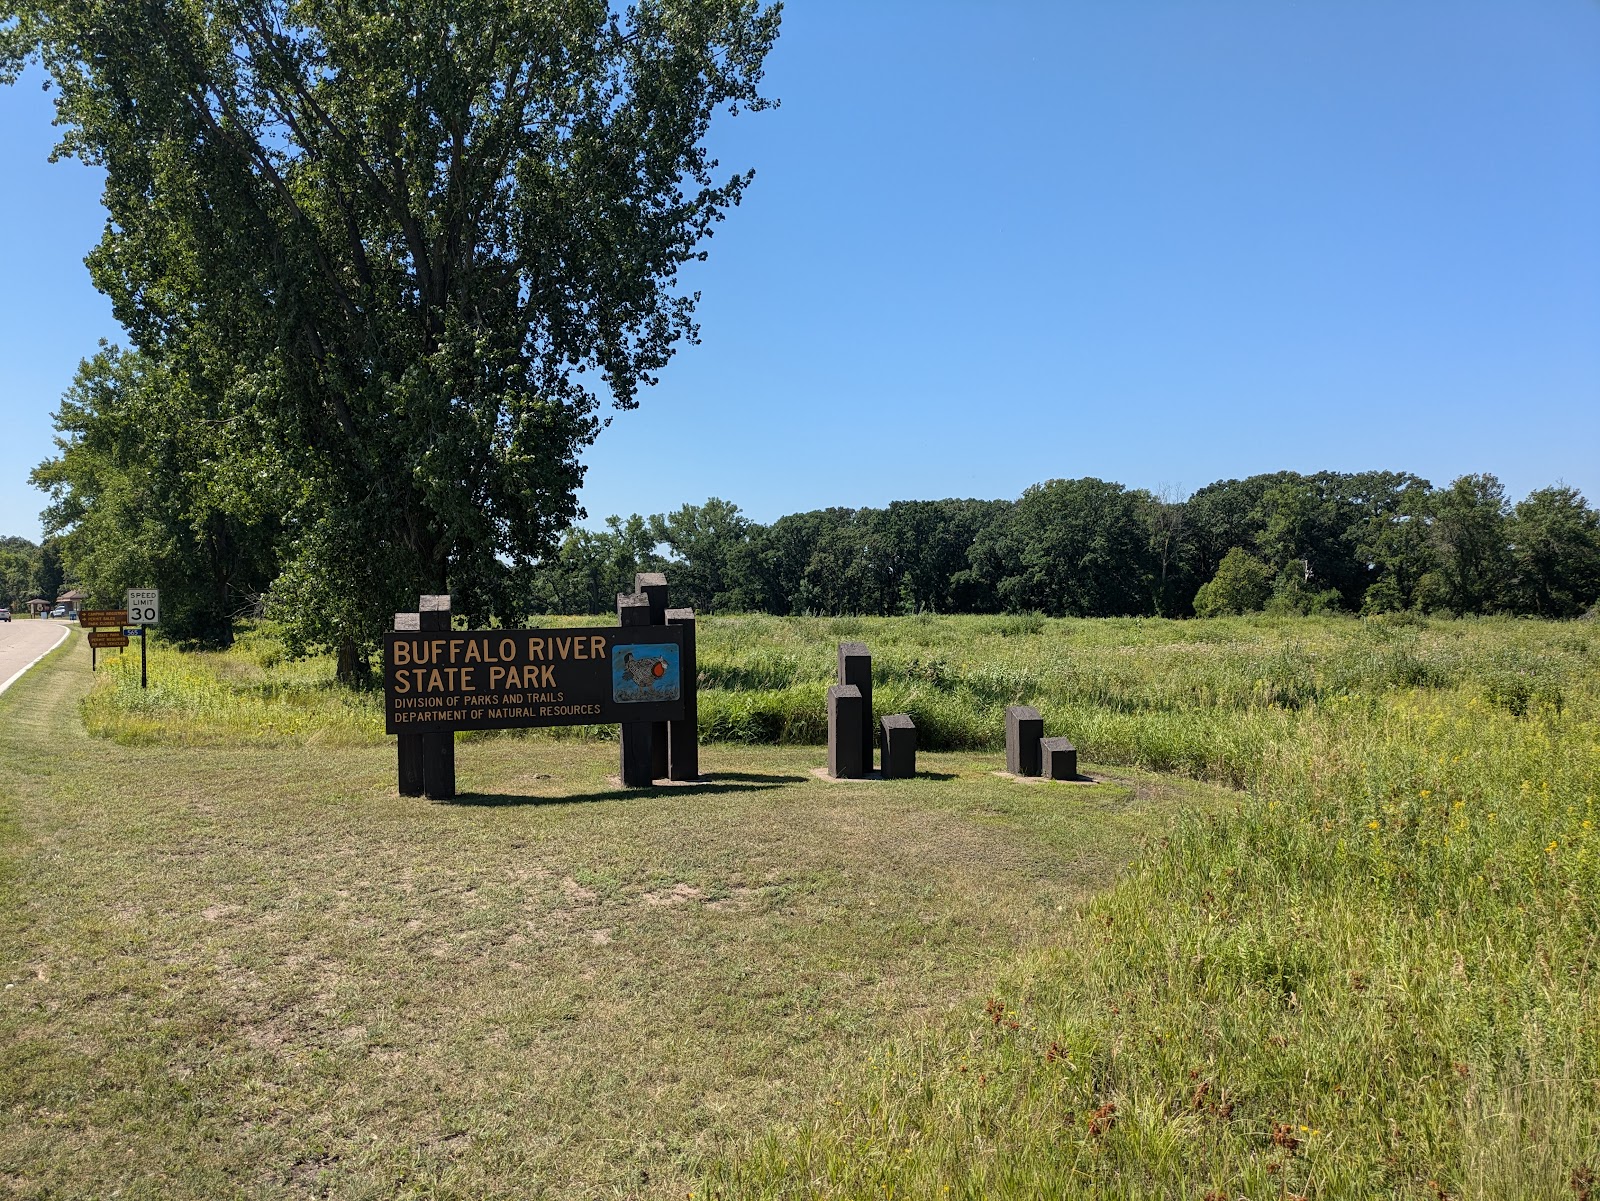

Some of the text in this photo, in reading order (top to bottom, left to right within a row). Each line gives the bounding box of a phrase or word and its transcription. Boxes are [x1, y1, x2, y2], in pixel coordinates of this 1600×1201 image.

[131, 607, 156, 621] 30
[394, 635, 606, 666] BUFFALO RIVER
[394, 664, 557, 694] STATE PARK
[394, 692, 564, 709] DIVISION OF PARKS AND TRAILS
[394, 704, 601, 723] DEPARTMENT OF NATURAL RESOURCES
